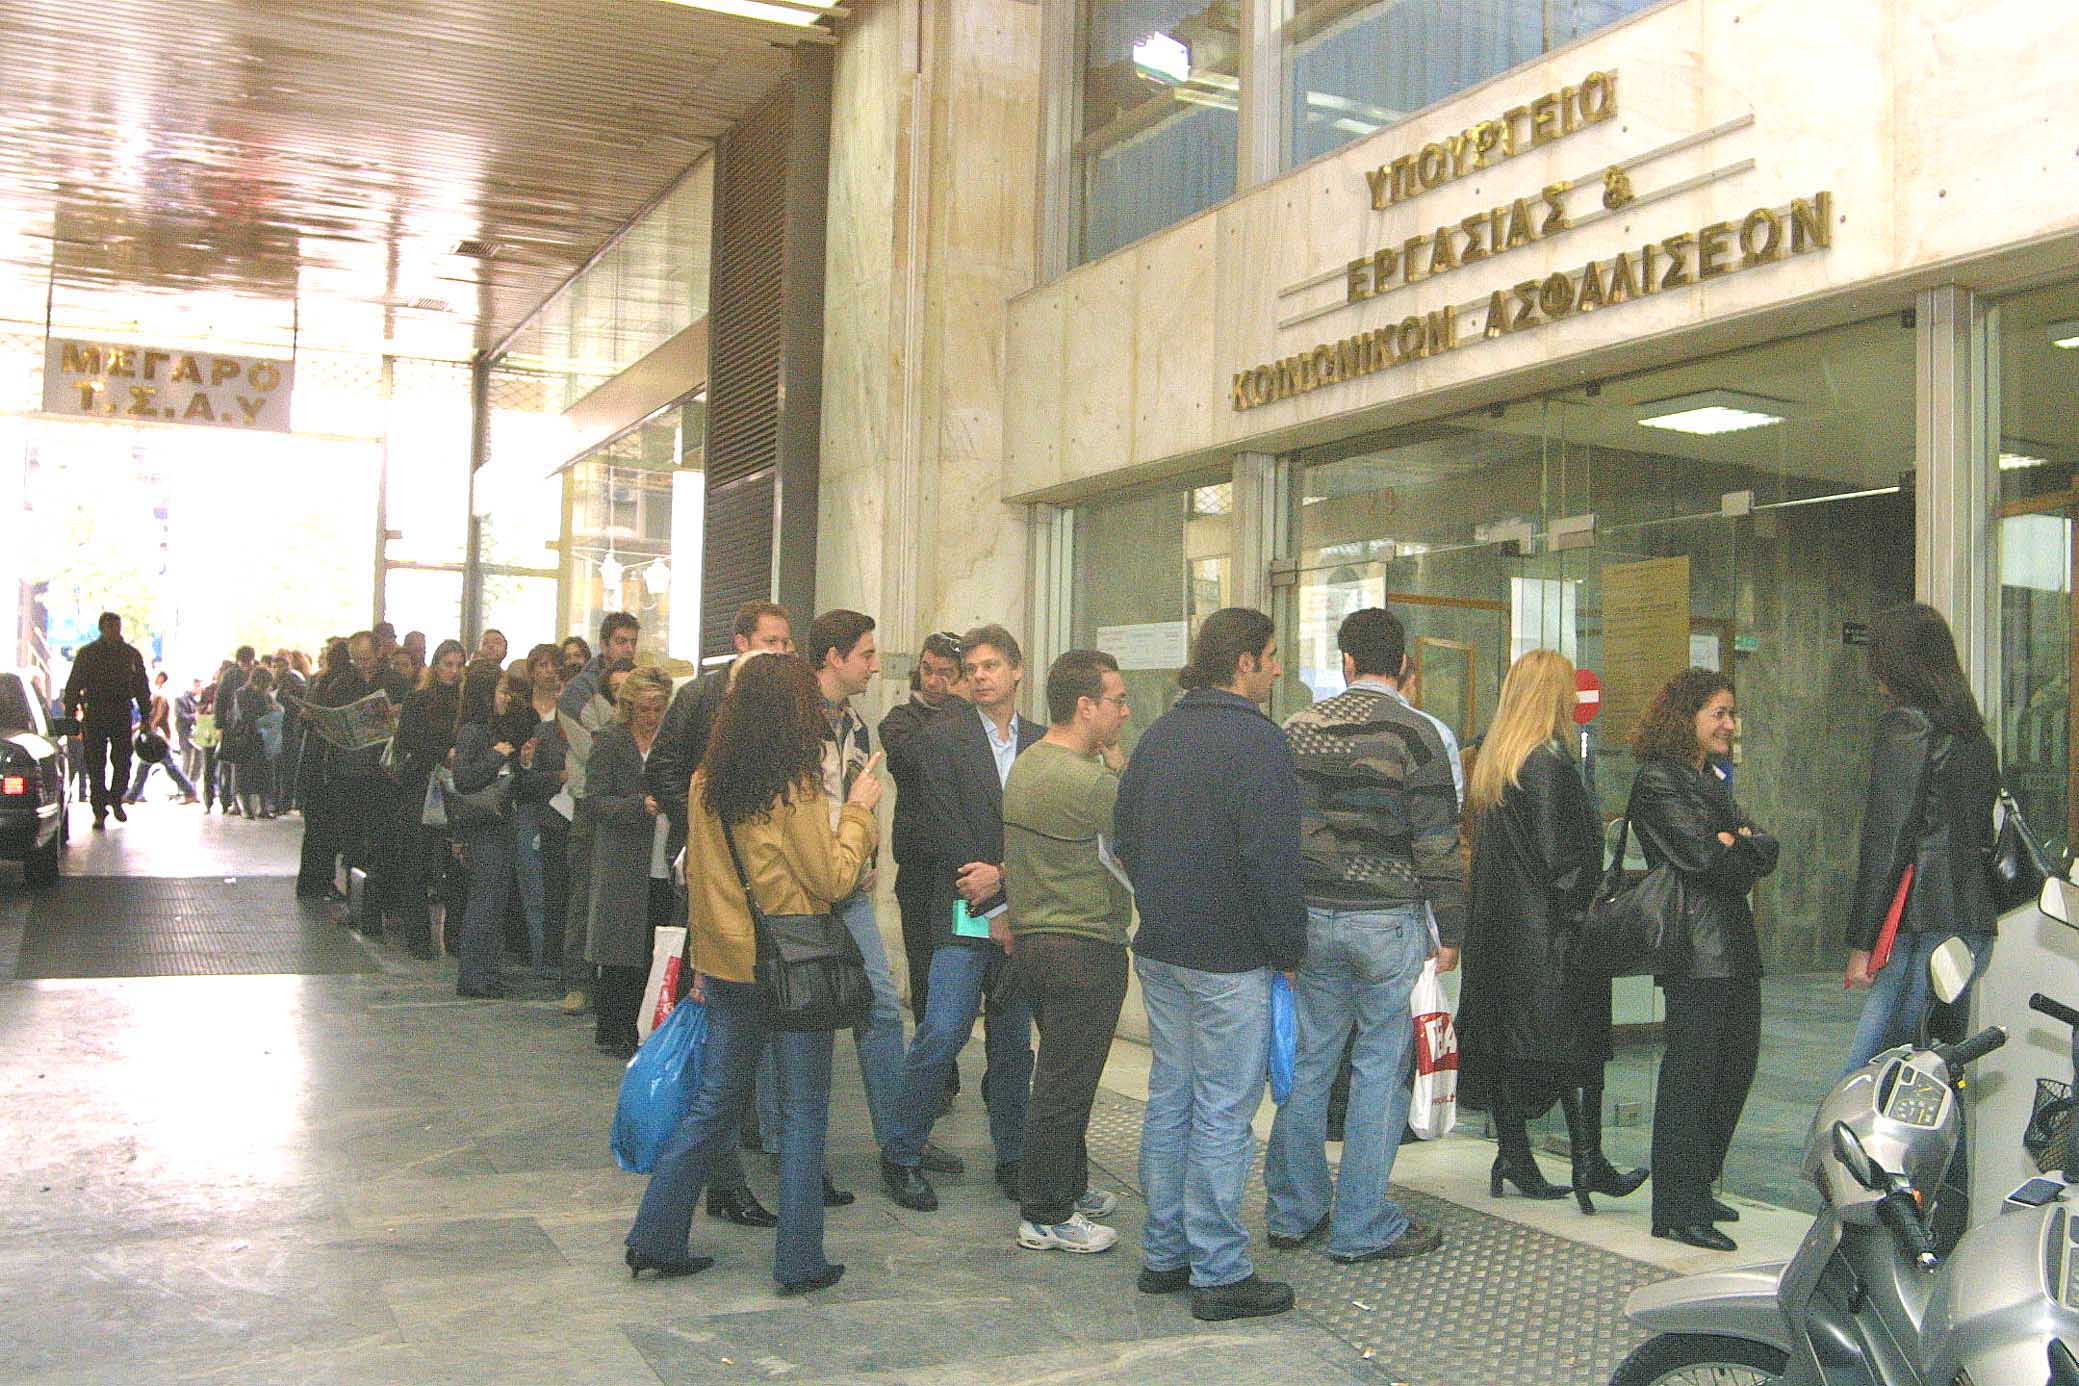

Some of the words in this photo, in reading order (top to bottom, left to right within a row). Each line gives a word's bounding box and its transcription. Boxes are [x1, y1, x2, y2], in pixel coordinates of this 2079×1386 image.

[1365, 71, 1618, 211] ΥΠΟΥΡΓΕΙΟ
[1347, 181, 1575, 303] ΕΡΓΑΣΙΑΣ
[1602, 164, 1634, 210] &
[61, 341, 281, 393] ΜΕΓΑΡΟ
